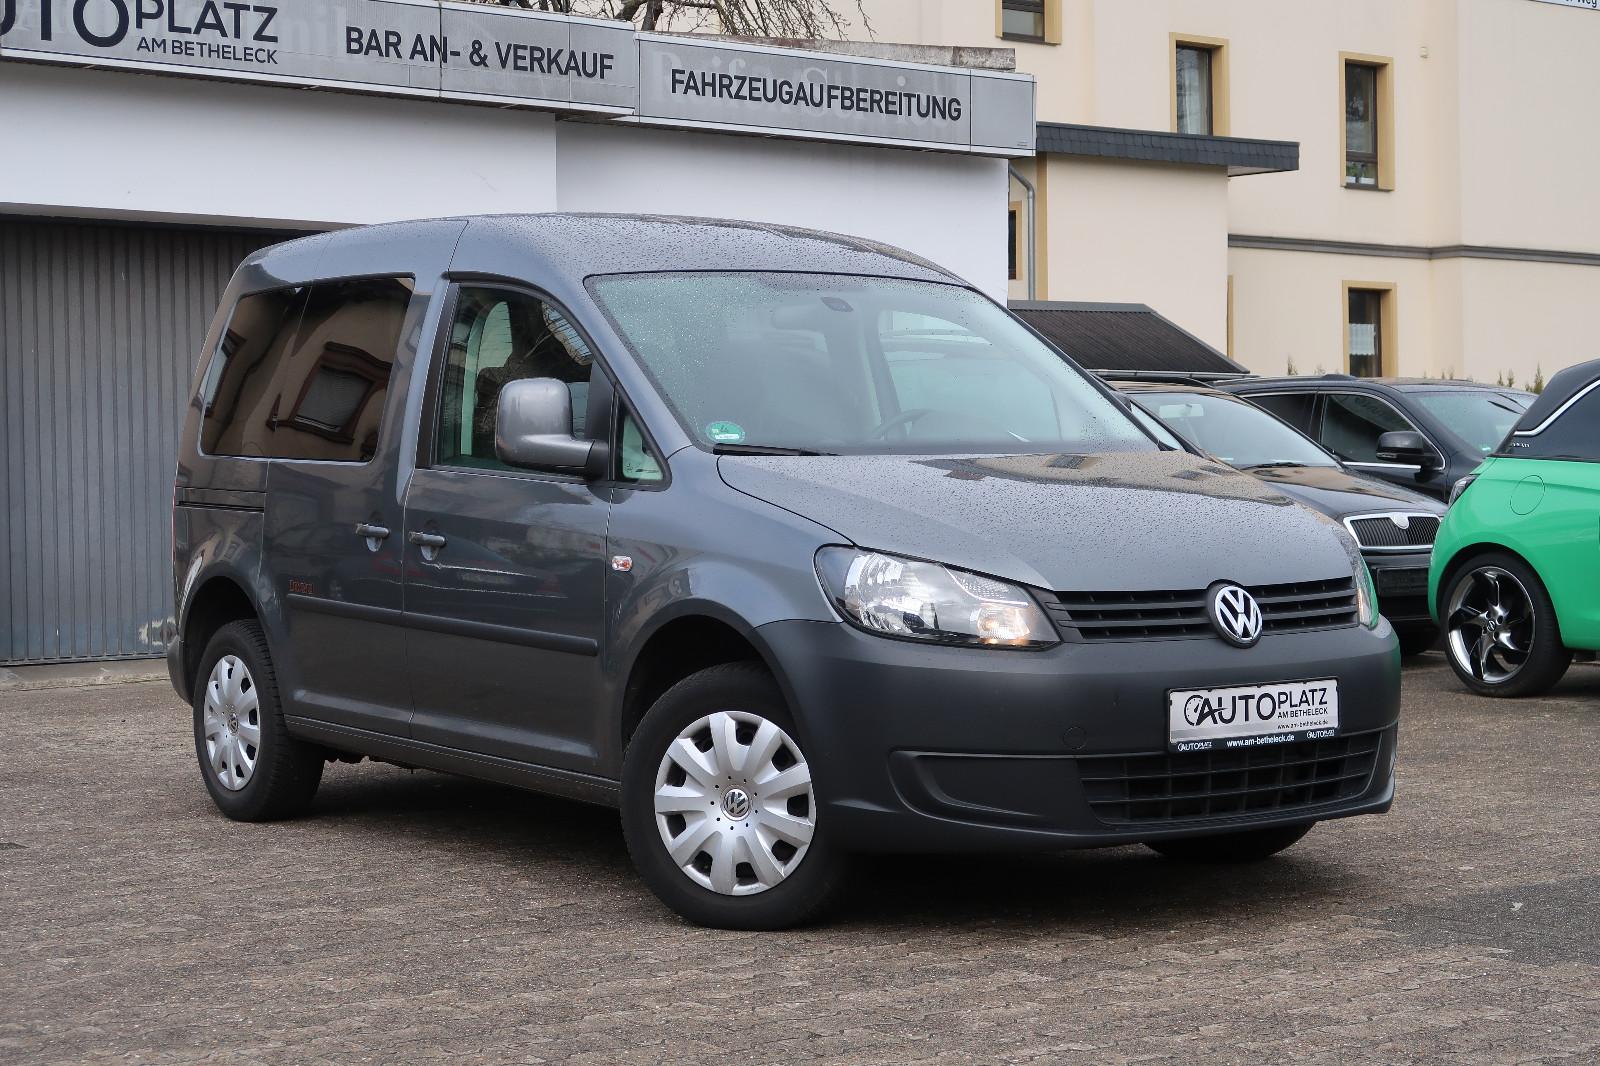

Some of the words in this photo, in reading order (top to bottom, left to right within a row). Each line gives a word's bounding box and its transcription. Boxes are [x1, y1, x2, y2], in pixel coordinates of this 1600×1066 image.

[136, 36, 167, 54] AM
[172, 40, 279, 65] BETHELECK
[345, 26, 402, 59] BAR
[409, 33, 461, 64] AN-
[469, 39, 489, 68] &
[495, 41, 614, 80] VERKAUF
[670, 68, 963, 122] FAHRZEUGAUFBEREITUNG
[1277, 711, 1289, 719] AM
[1290, 707, 1328, 718] BETHELECK
[1226, 733, 1295, 747] www.am-betheleck.de
